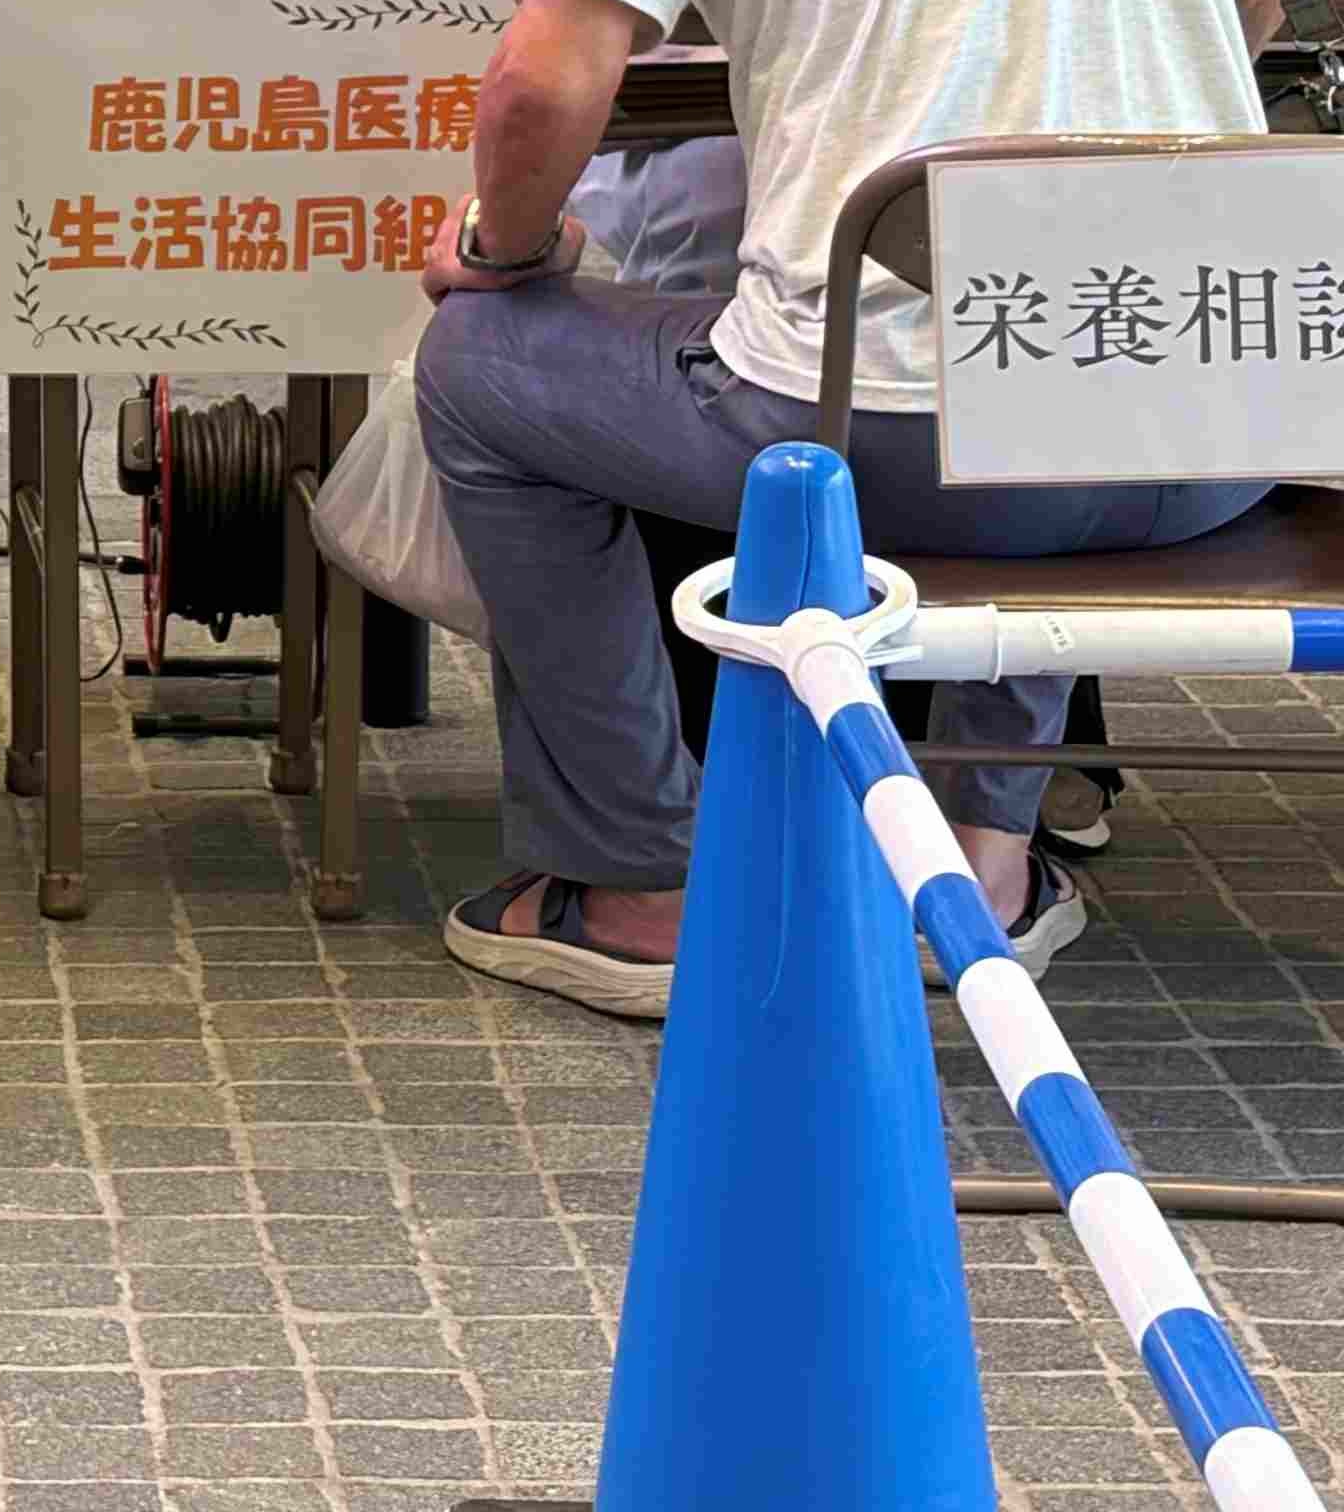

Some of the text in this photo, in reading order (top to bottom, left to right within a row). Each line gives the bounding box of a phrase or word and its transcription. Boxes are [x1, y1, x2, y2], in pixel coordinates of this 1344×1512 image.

[87, 73, 483, 153] 鹿児島医療
[47, 193, 448, 273] 生活協同組
